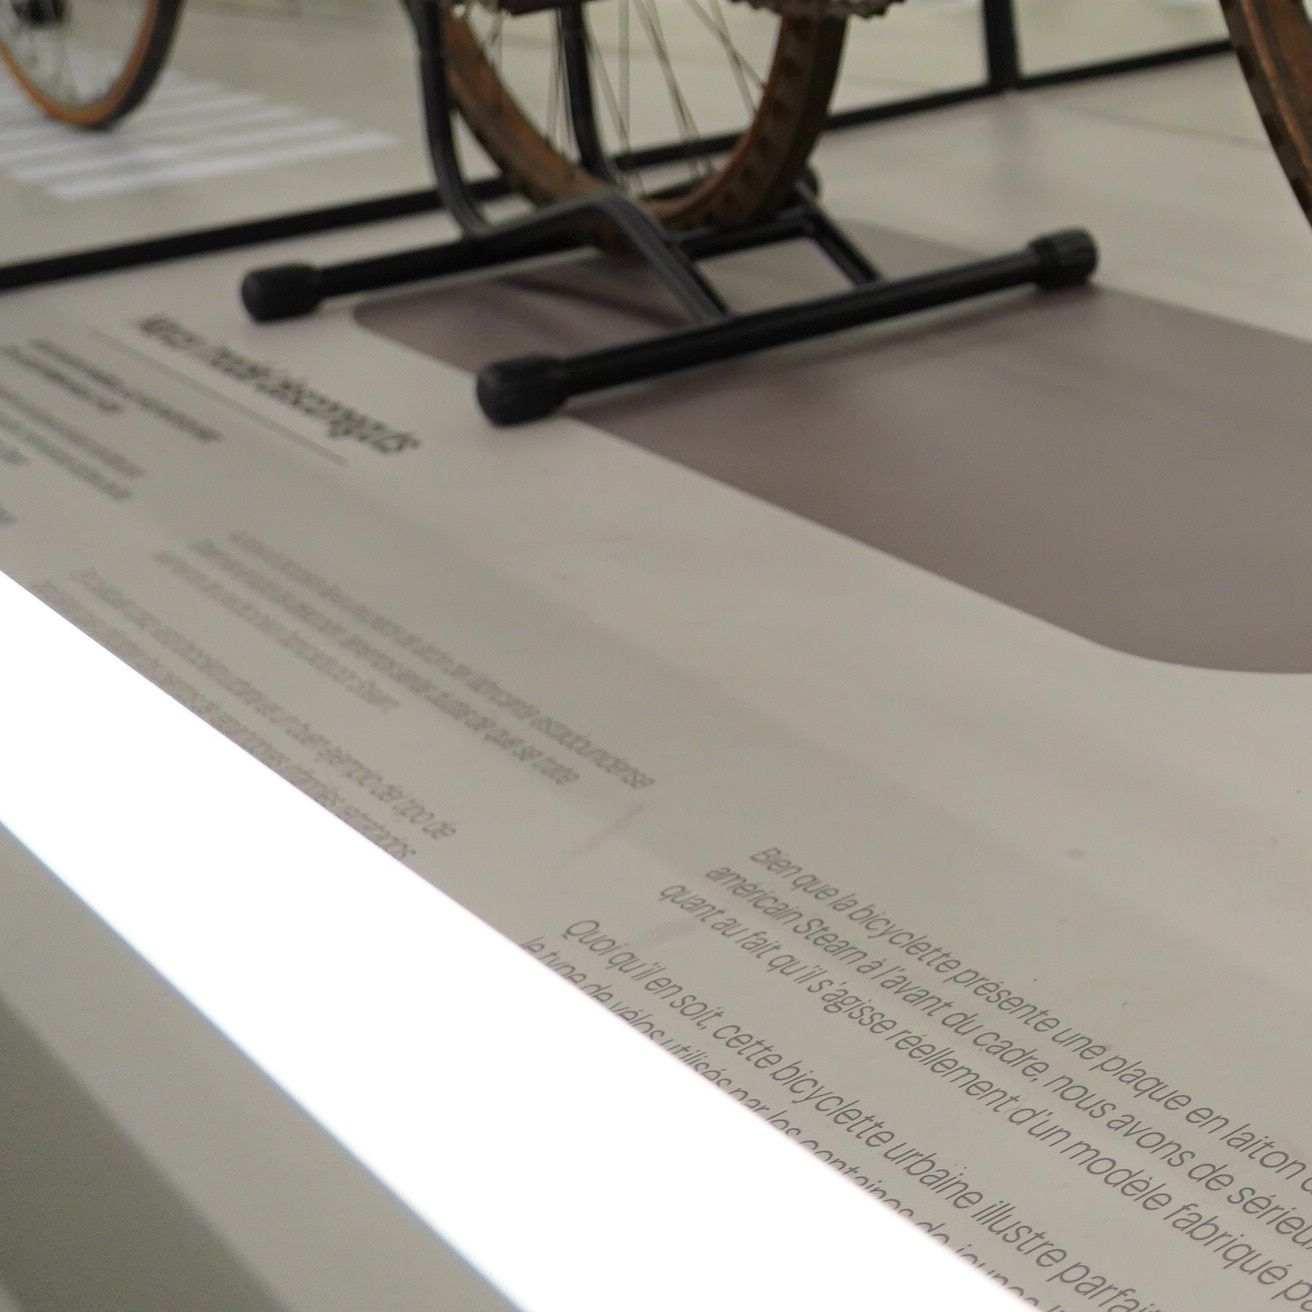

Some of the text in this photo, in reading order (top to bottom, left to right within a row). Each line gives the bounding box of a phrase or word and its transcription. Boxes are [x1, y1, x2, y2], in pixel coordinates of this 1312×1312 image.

[560, 919, 628, 957] Quoi
[643, 976, 684, 1001] en
[668, 994, 725, 1031] soit,
[711, 1023, 784, 1071] cette
[768, 1059, 896, 1149] bicyclette
[882, 1141, 984, 1210] urbaine
[970, 1199, 1068, 1268] illustre
[659, 884, 727, 923] quant
[710, 917, 750, 939] au
[735, 930, 782, 960] fait
[765, 952, 829, 985] qu'il
[806, 977, 898, 1036] s'agisse
[884, 1028, 1021, 1114] réellement
[1007, 1106, 1072, 1148] d'un
[1059, 1139, 1173, 1211] modèle
[1162, 1202, 1293, 1286] fabriqué
[705, 866, 804, 927] américain
[792, 917, 868, 967] Stearn
[856, 958, 888, 975] à
[879, 966, 953, 1018] l'avant
[941, 1013, 985, 1037] du
[972, 1031, 1050, 1083] cadre,
[1042, 1074, 1117, 1120] nous
[1106, 1114, 1196, 1169] avons
[1187, 1163, 1235, 1192] de
[751, 846, 803, 879] Bien
[791, 873, 840, 901] que
[828, 892, 858, 913] la
[847, 903, 961, 974] bicyclette
[942, 969, 1061, 1033] présente
[1051, 1027, 1107, 1061] une
[1089, 1054, 1193, 1112] plaque
[1185, 1106, 1230, 1135] en
[1219, 1123, 1307, 1181] laiton
